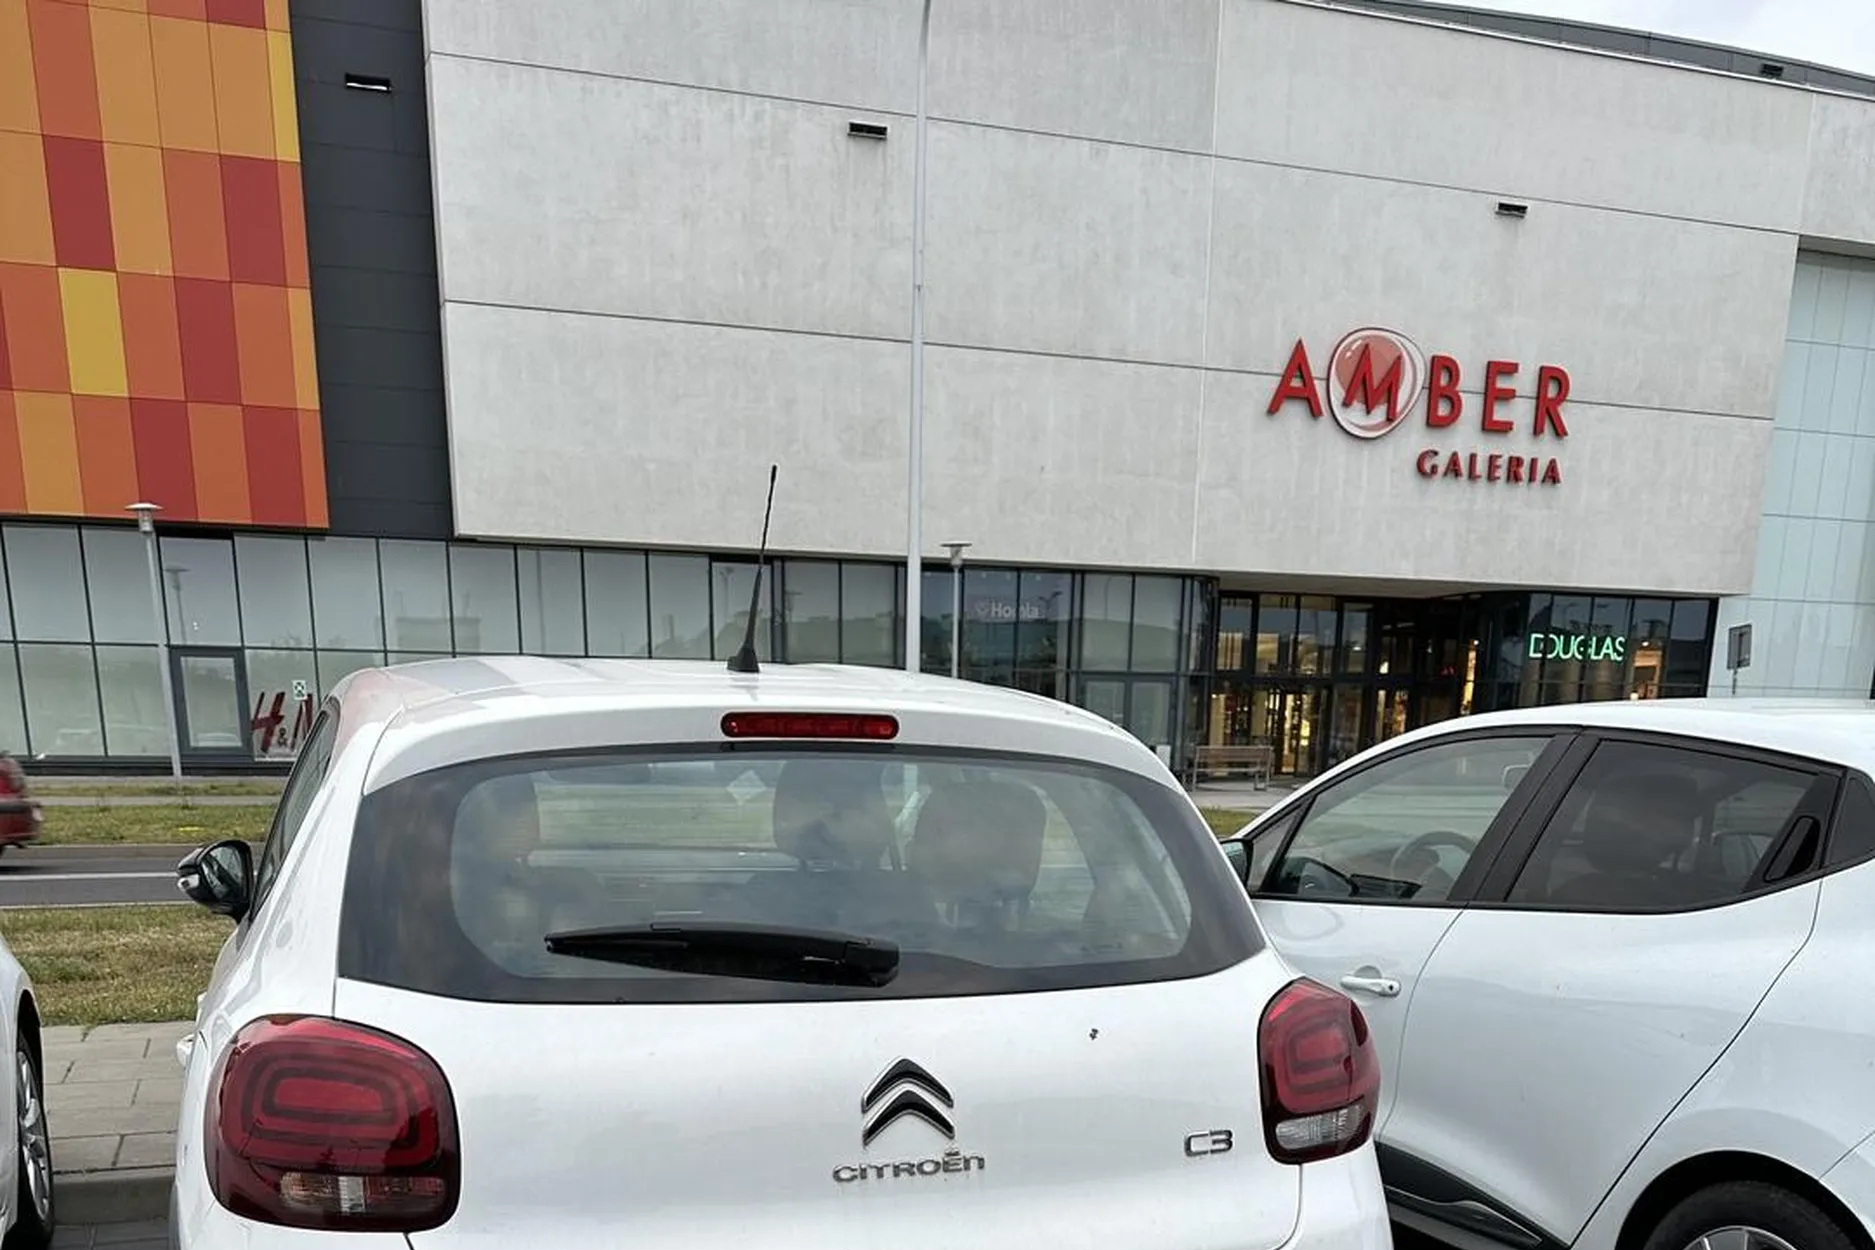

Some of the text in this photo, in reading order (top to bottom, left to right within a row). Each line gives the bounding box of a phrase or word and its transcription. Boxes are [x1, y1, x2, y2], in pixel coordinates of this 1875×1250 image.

[1267, 336, 1571, 438] AMBER
[1416, 449, 1562, 485] GALERIA
[1529, 633, 1626, 661] DOUGLAS
[1184, 1129, 1233, 1157] C3
